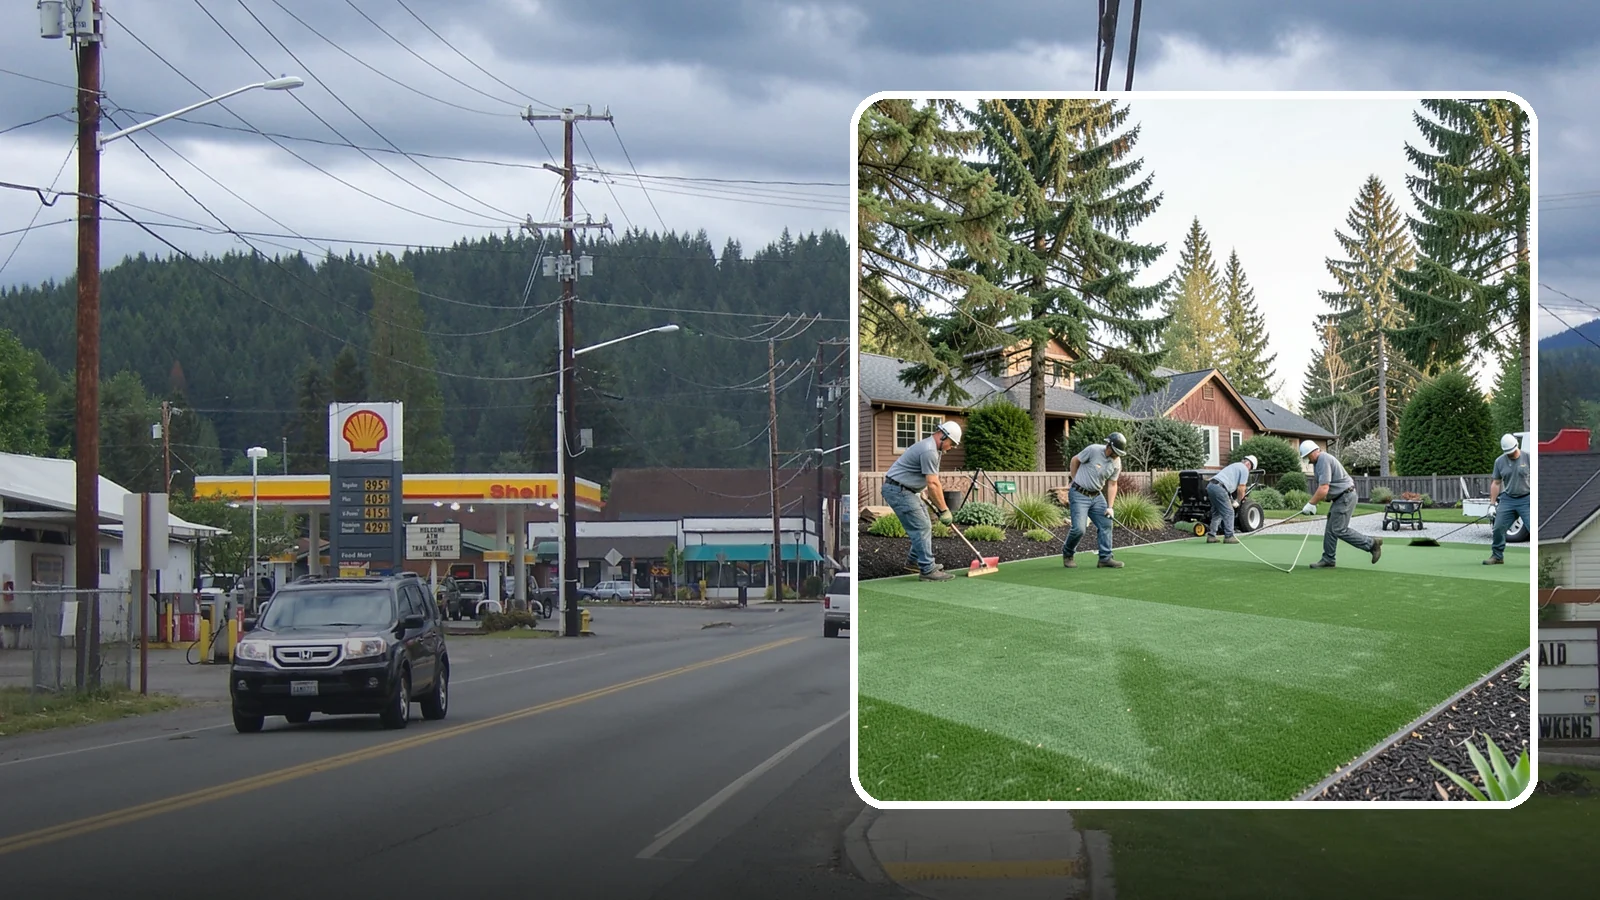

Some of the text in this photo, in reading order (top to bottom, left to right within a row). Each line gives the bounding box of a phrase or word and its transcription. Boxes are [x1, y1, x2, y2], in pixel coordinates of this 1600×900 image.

[366, 480, 384, 491] 395
[490, 484, 547, 499] Shell
[366, 494, 384, 504] 405
[366, 507, 384, 518] 415
[366, 522, 384, 533] 429
